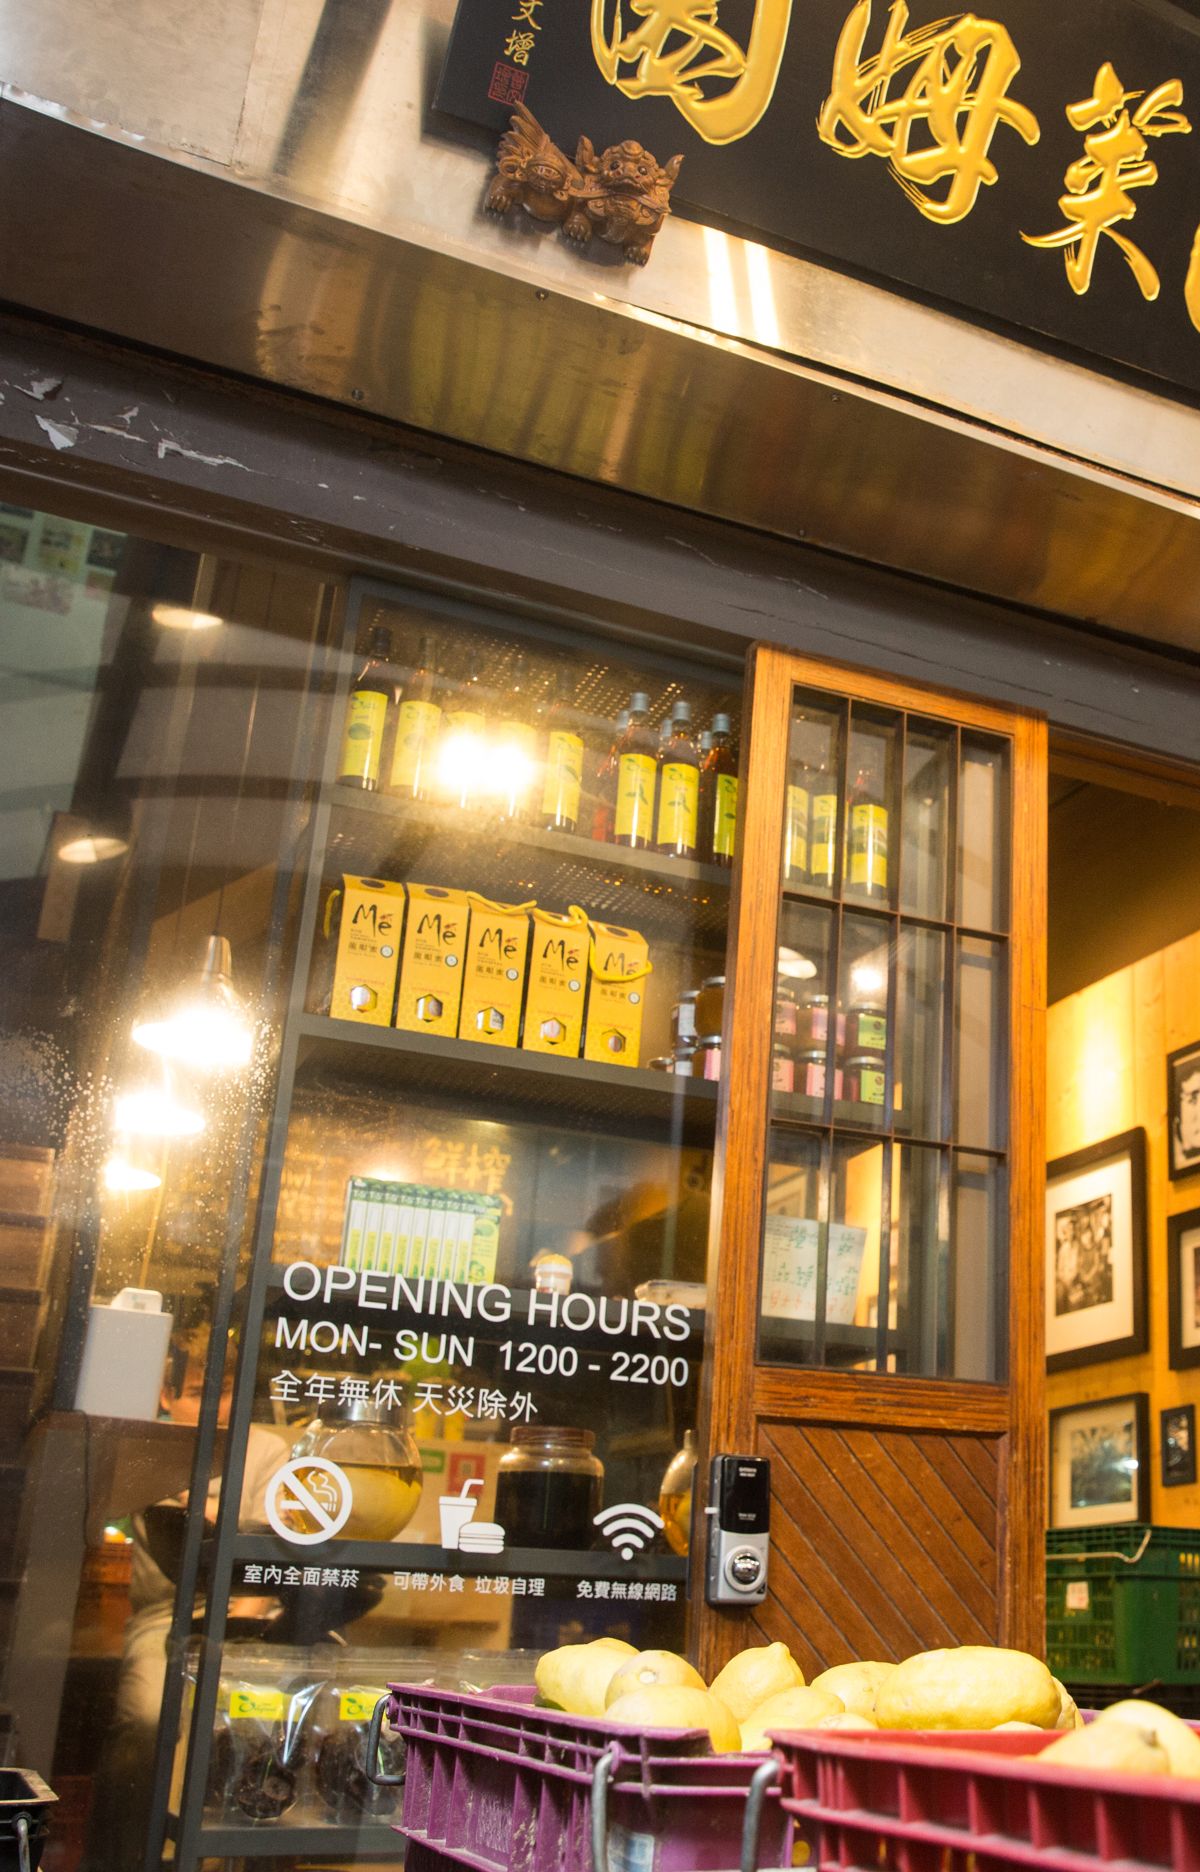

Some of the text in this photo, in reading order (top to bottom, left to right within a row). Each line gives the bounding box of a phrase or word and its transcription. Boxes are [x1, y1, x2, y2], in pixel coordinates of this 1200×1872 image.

[283, 1260, 692, 1342] OPENING HOURS
[274, 1316, 382, 1356] MON-
[393, 1329, 475, 1367] SUN
[499, 1341, 579, 1378] 1200
[609, 1352, 690, 1388] 2200
[269, 1369, 539, 1423] 全年無休 天災除外
[243, 1564, 360, 1589] 室內全面禁菸
[393, 1570, 546, 1598] 可帶外食 垃圾自理
[576, 1580, 678, 1602] 免費無線網路
